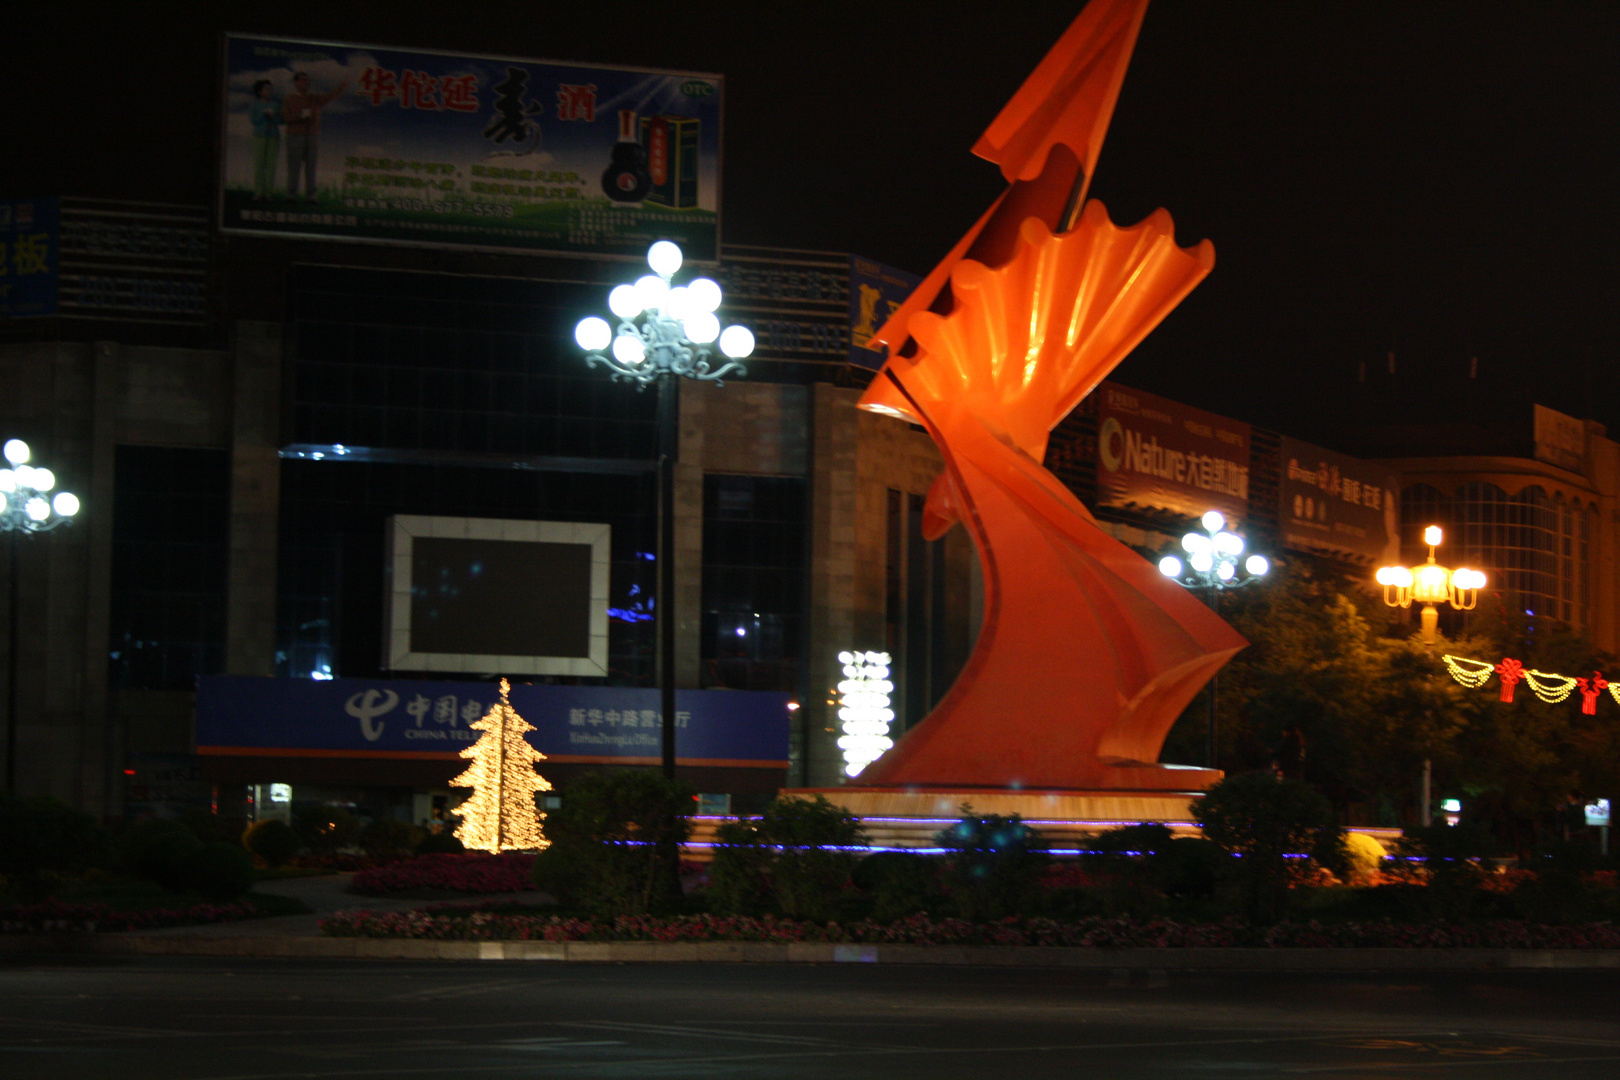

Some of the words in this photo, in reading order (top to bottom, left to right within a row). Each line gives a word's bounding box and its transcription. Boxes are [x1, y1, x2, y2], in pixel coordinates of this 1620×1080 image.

[685, 84, 711, 96] OTC
[0, 232, 51, 277] 板
[1125, 428, 1187, 483] Nature
[405, 692, 491, 728] 中国电
[403, 728, 448, 740] CHINA
